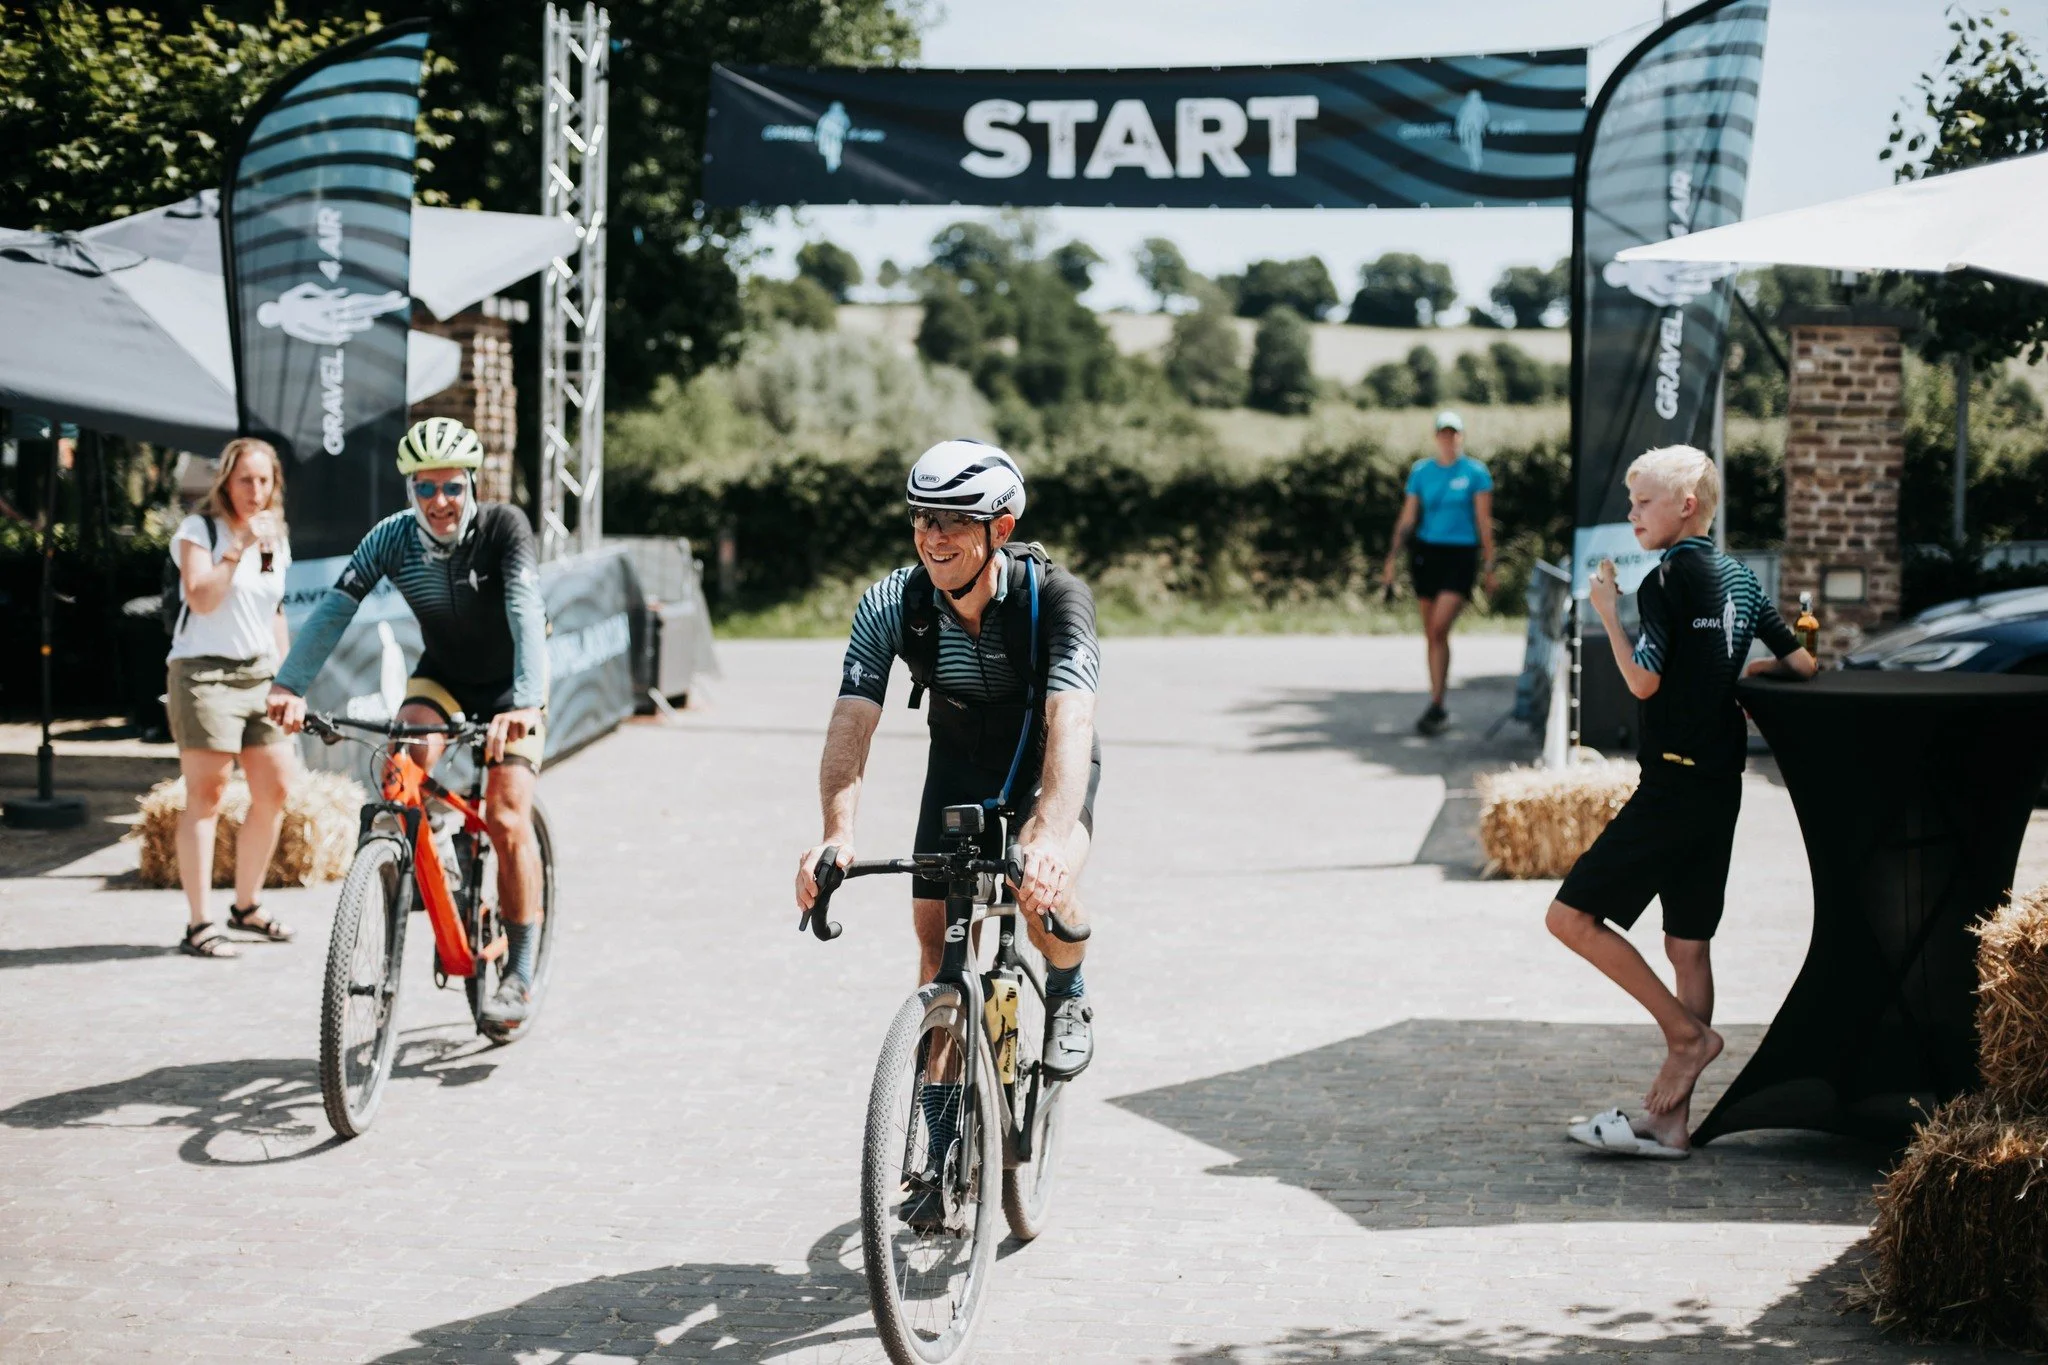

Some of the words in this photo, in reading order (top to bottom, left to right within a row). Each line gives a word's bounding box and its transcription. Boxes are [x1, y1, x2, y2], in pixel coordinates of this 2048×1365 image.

[960, 95, 1319, 179] START
[1669, 170, 1693, 225] AIR
[317, 207, 343, 260] AIR
[318, 260, 343, 283] 4
[1655, 310, 1684, 420] GRAVEL
[321, 349, 345, 456] GRAVEL
[996, 488, 1016, 508] ABUS
[945, 917, 969, 943] é
